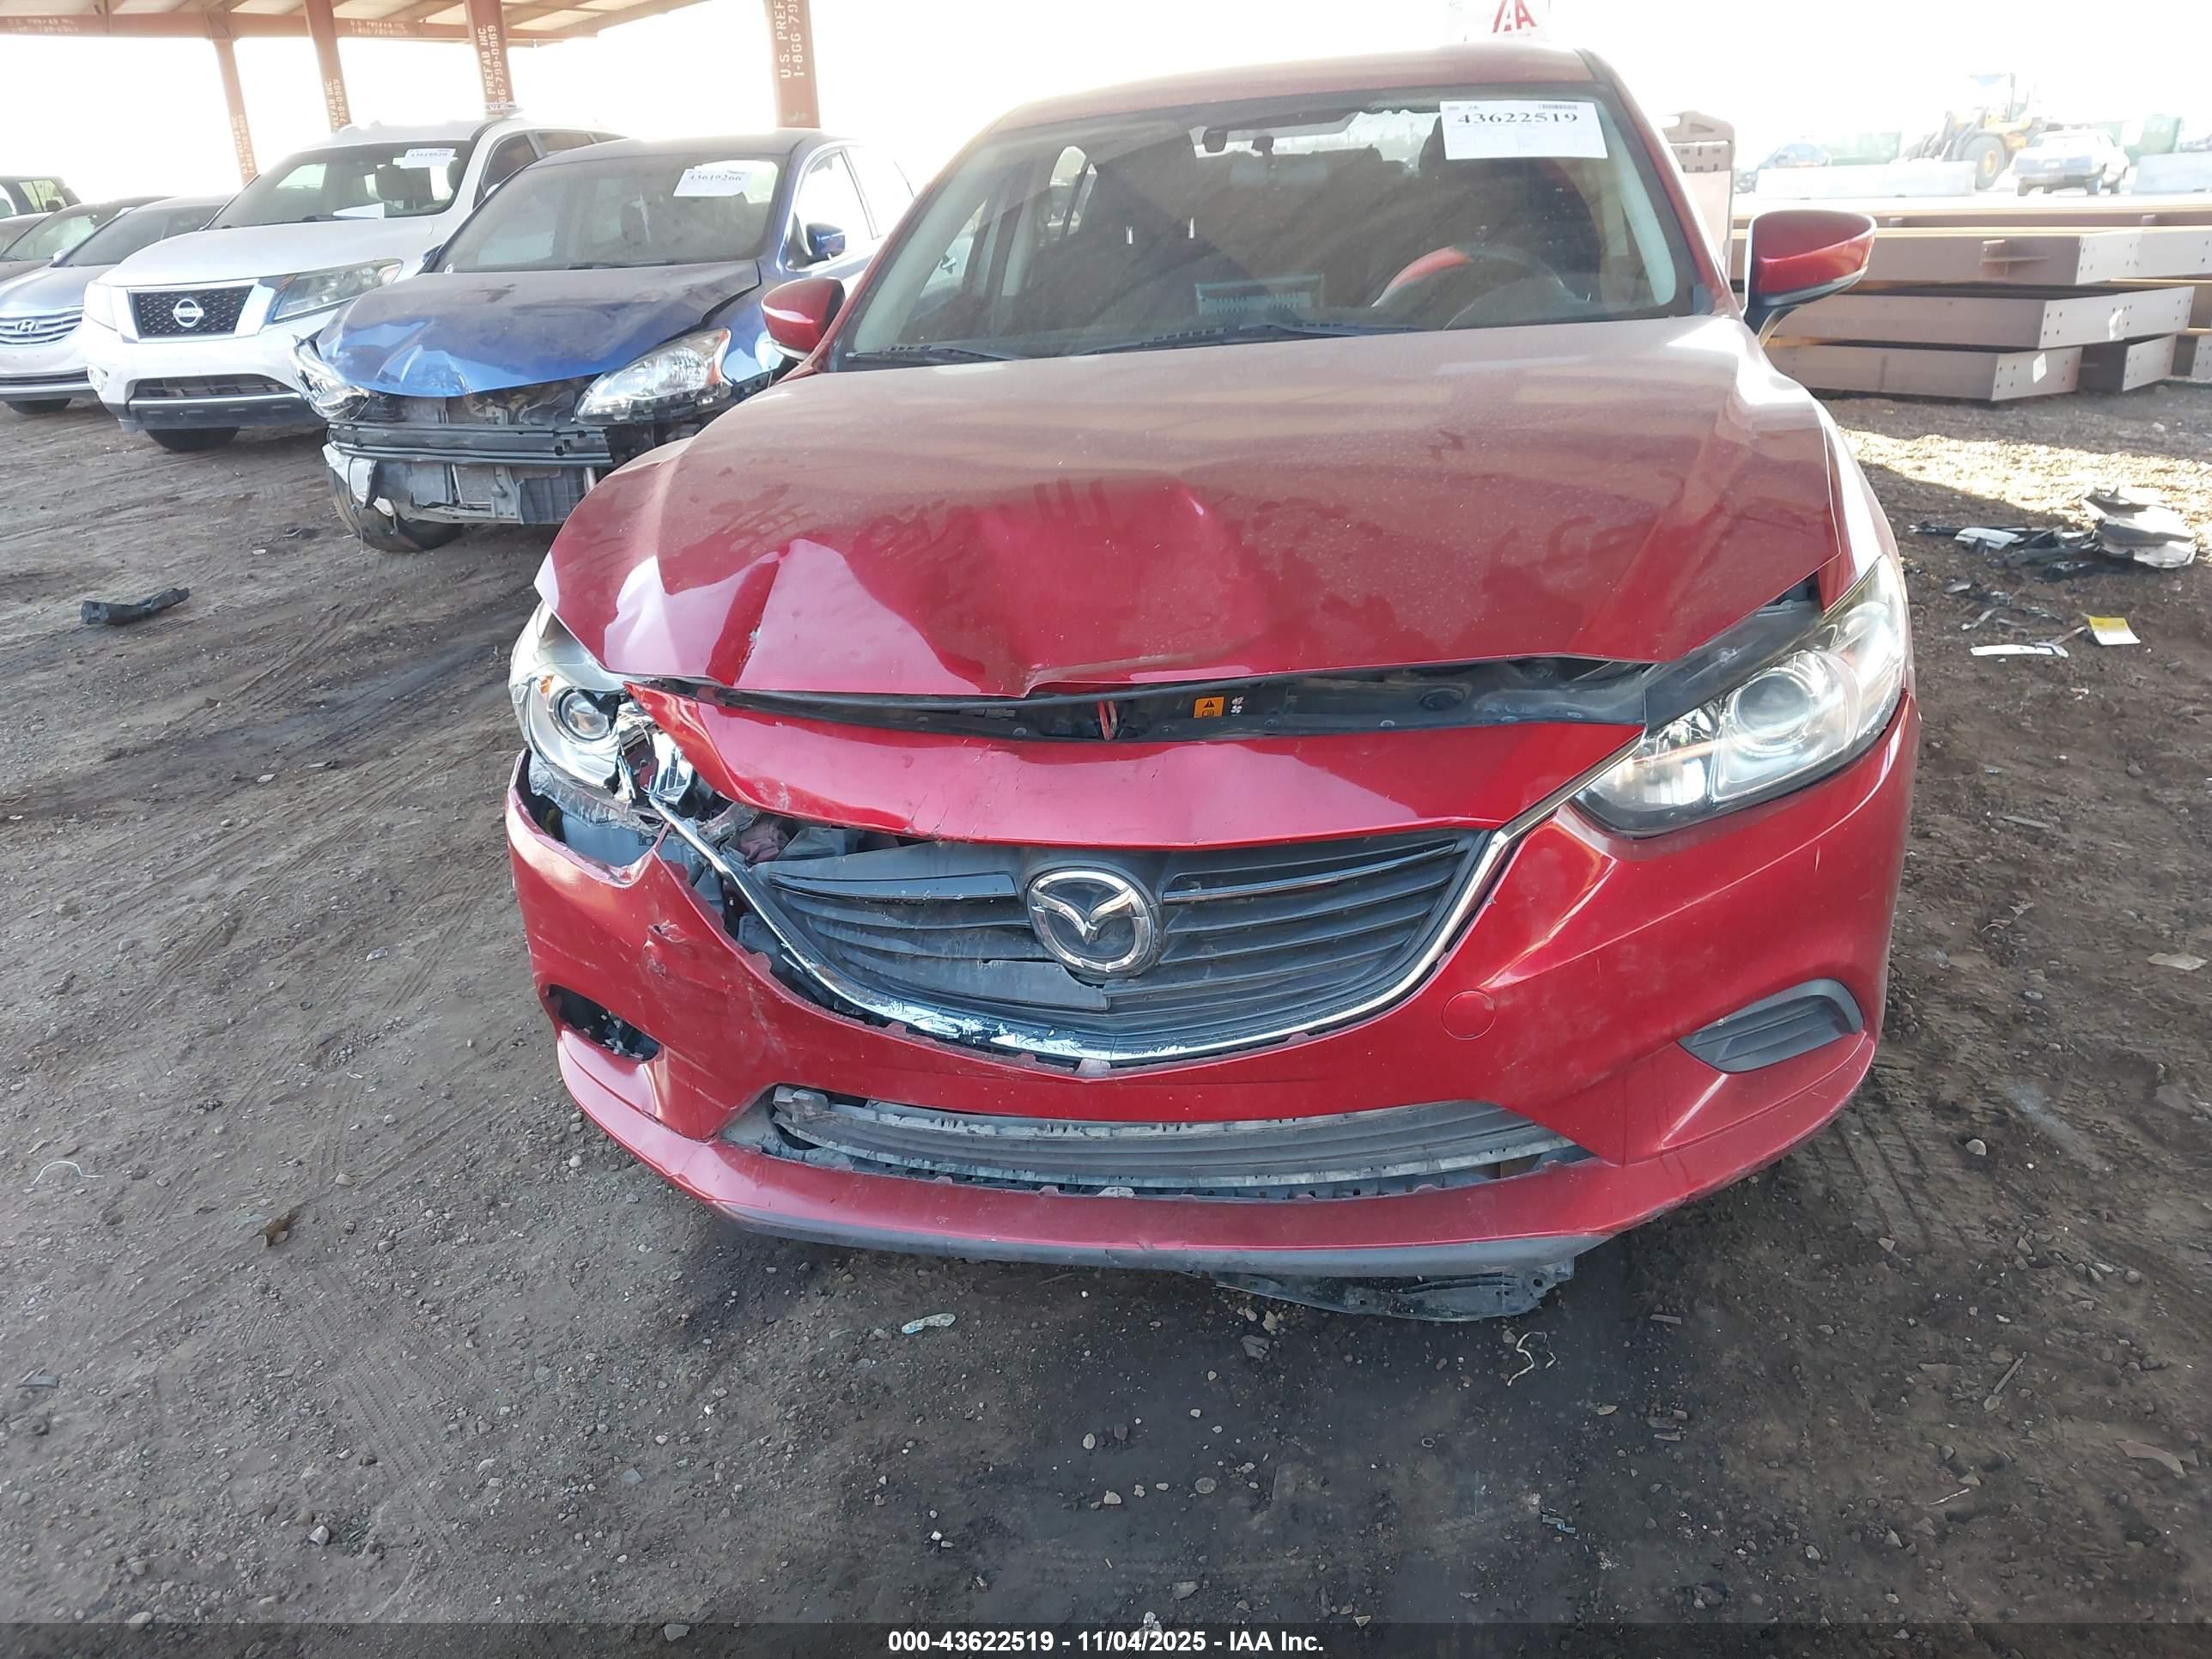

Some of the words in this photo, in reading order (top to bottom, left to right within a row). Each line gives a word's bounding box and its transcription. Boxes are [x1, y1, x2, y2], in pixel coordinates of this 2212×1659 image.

[775, 0, 788, 40] PREF
[787, 0, 805, 76] 1-866-79
[481, 52, 496, 94] PREFAB
[487, 25, 507, 103] 66-799-0969
[779, 48, 792, 79] U.S.
[1457, 112, 1578, 124] 43622519
